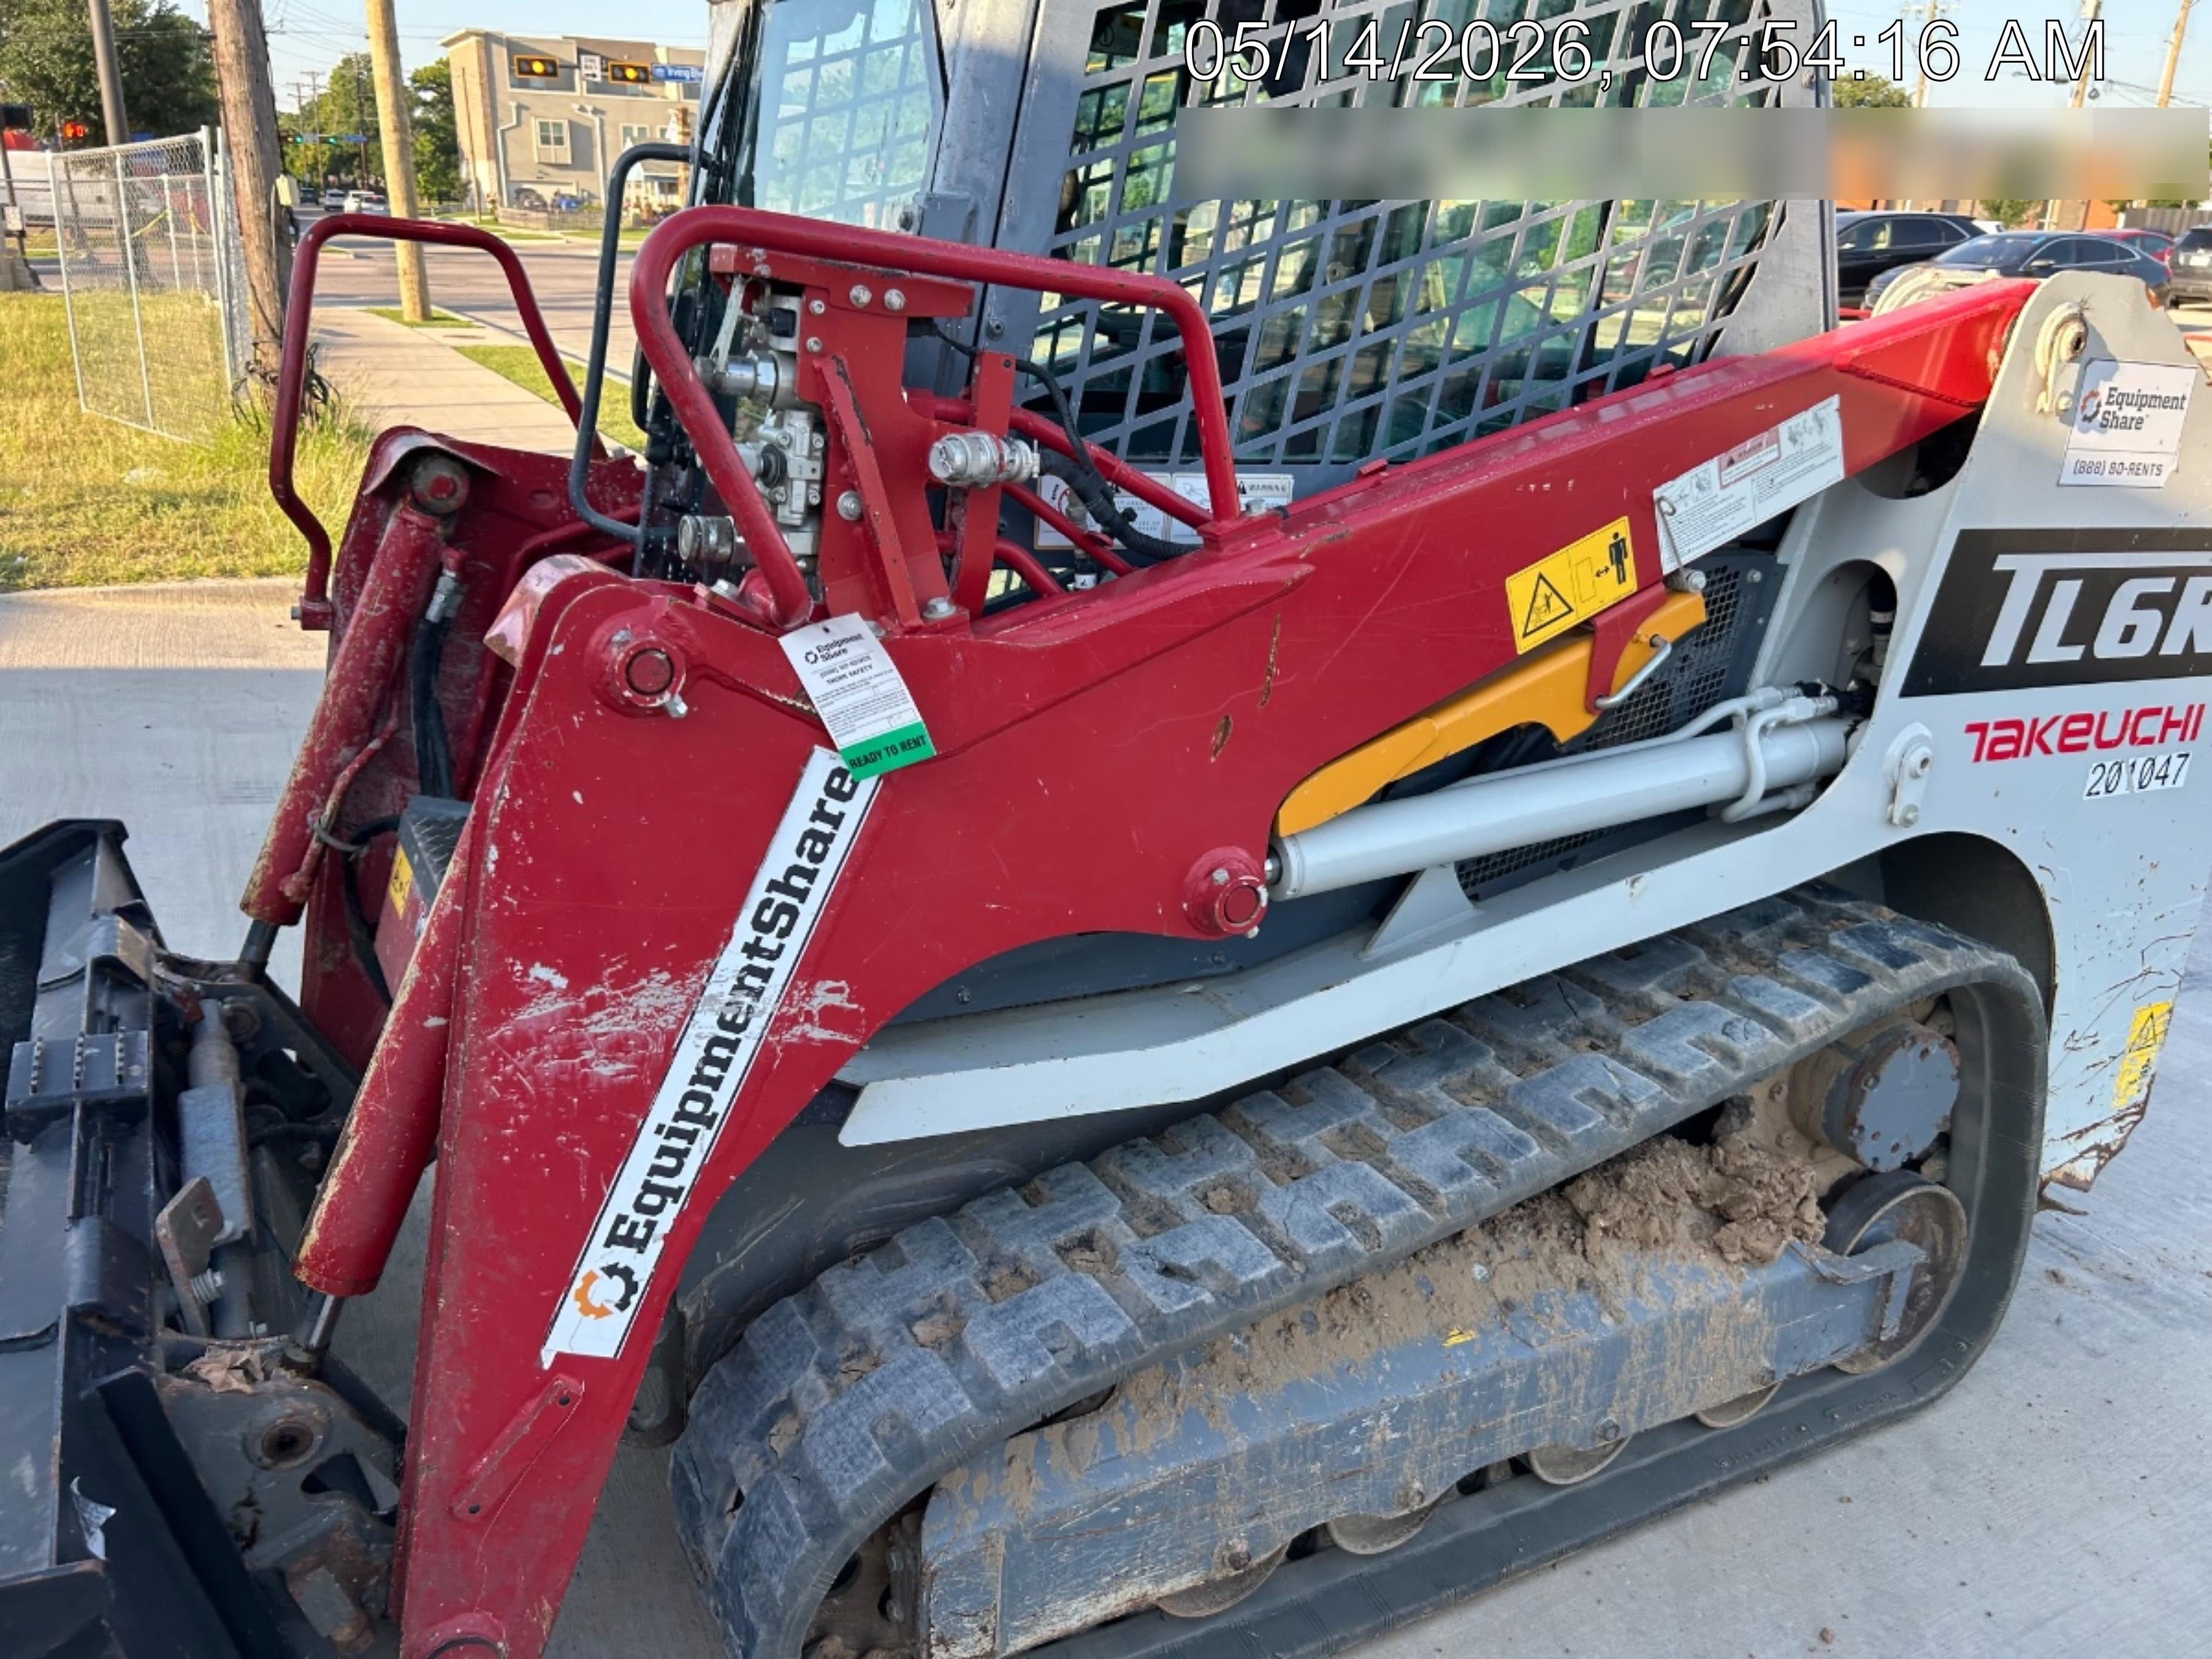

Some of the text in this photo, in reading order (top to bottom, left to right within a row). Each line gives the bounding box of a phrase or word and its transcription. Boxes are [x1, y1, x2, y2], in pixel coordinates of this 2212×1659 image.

[2105, 387, 2186, 411] Equipment
[2100, 410, 2144, 430] Share
[1965, 704, 2206, 763] TAKEUCHI
[849, 735, 926, 768] READY TO RENT
[603, 766, 860, 1255] EquipmentShare
